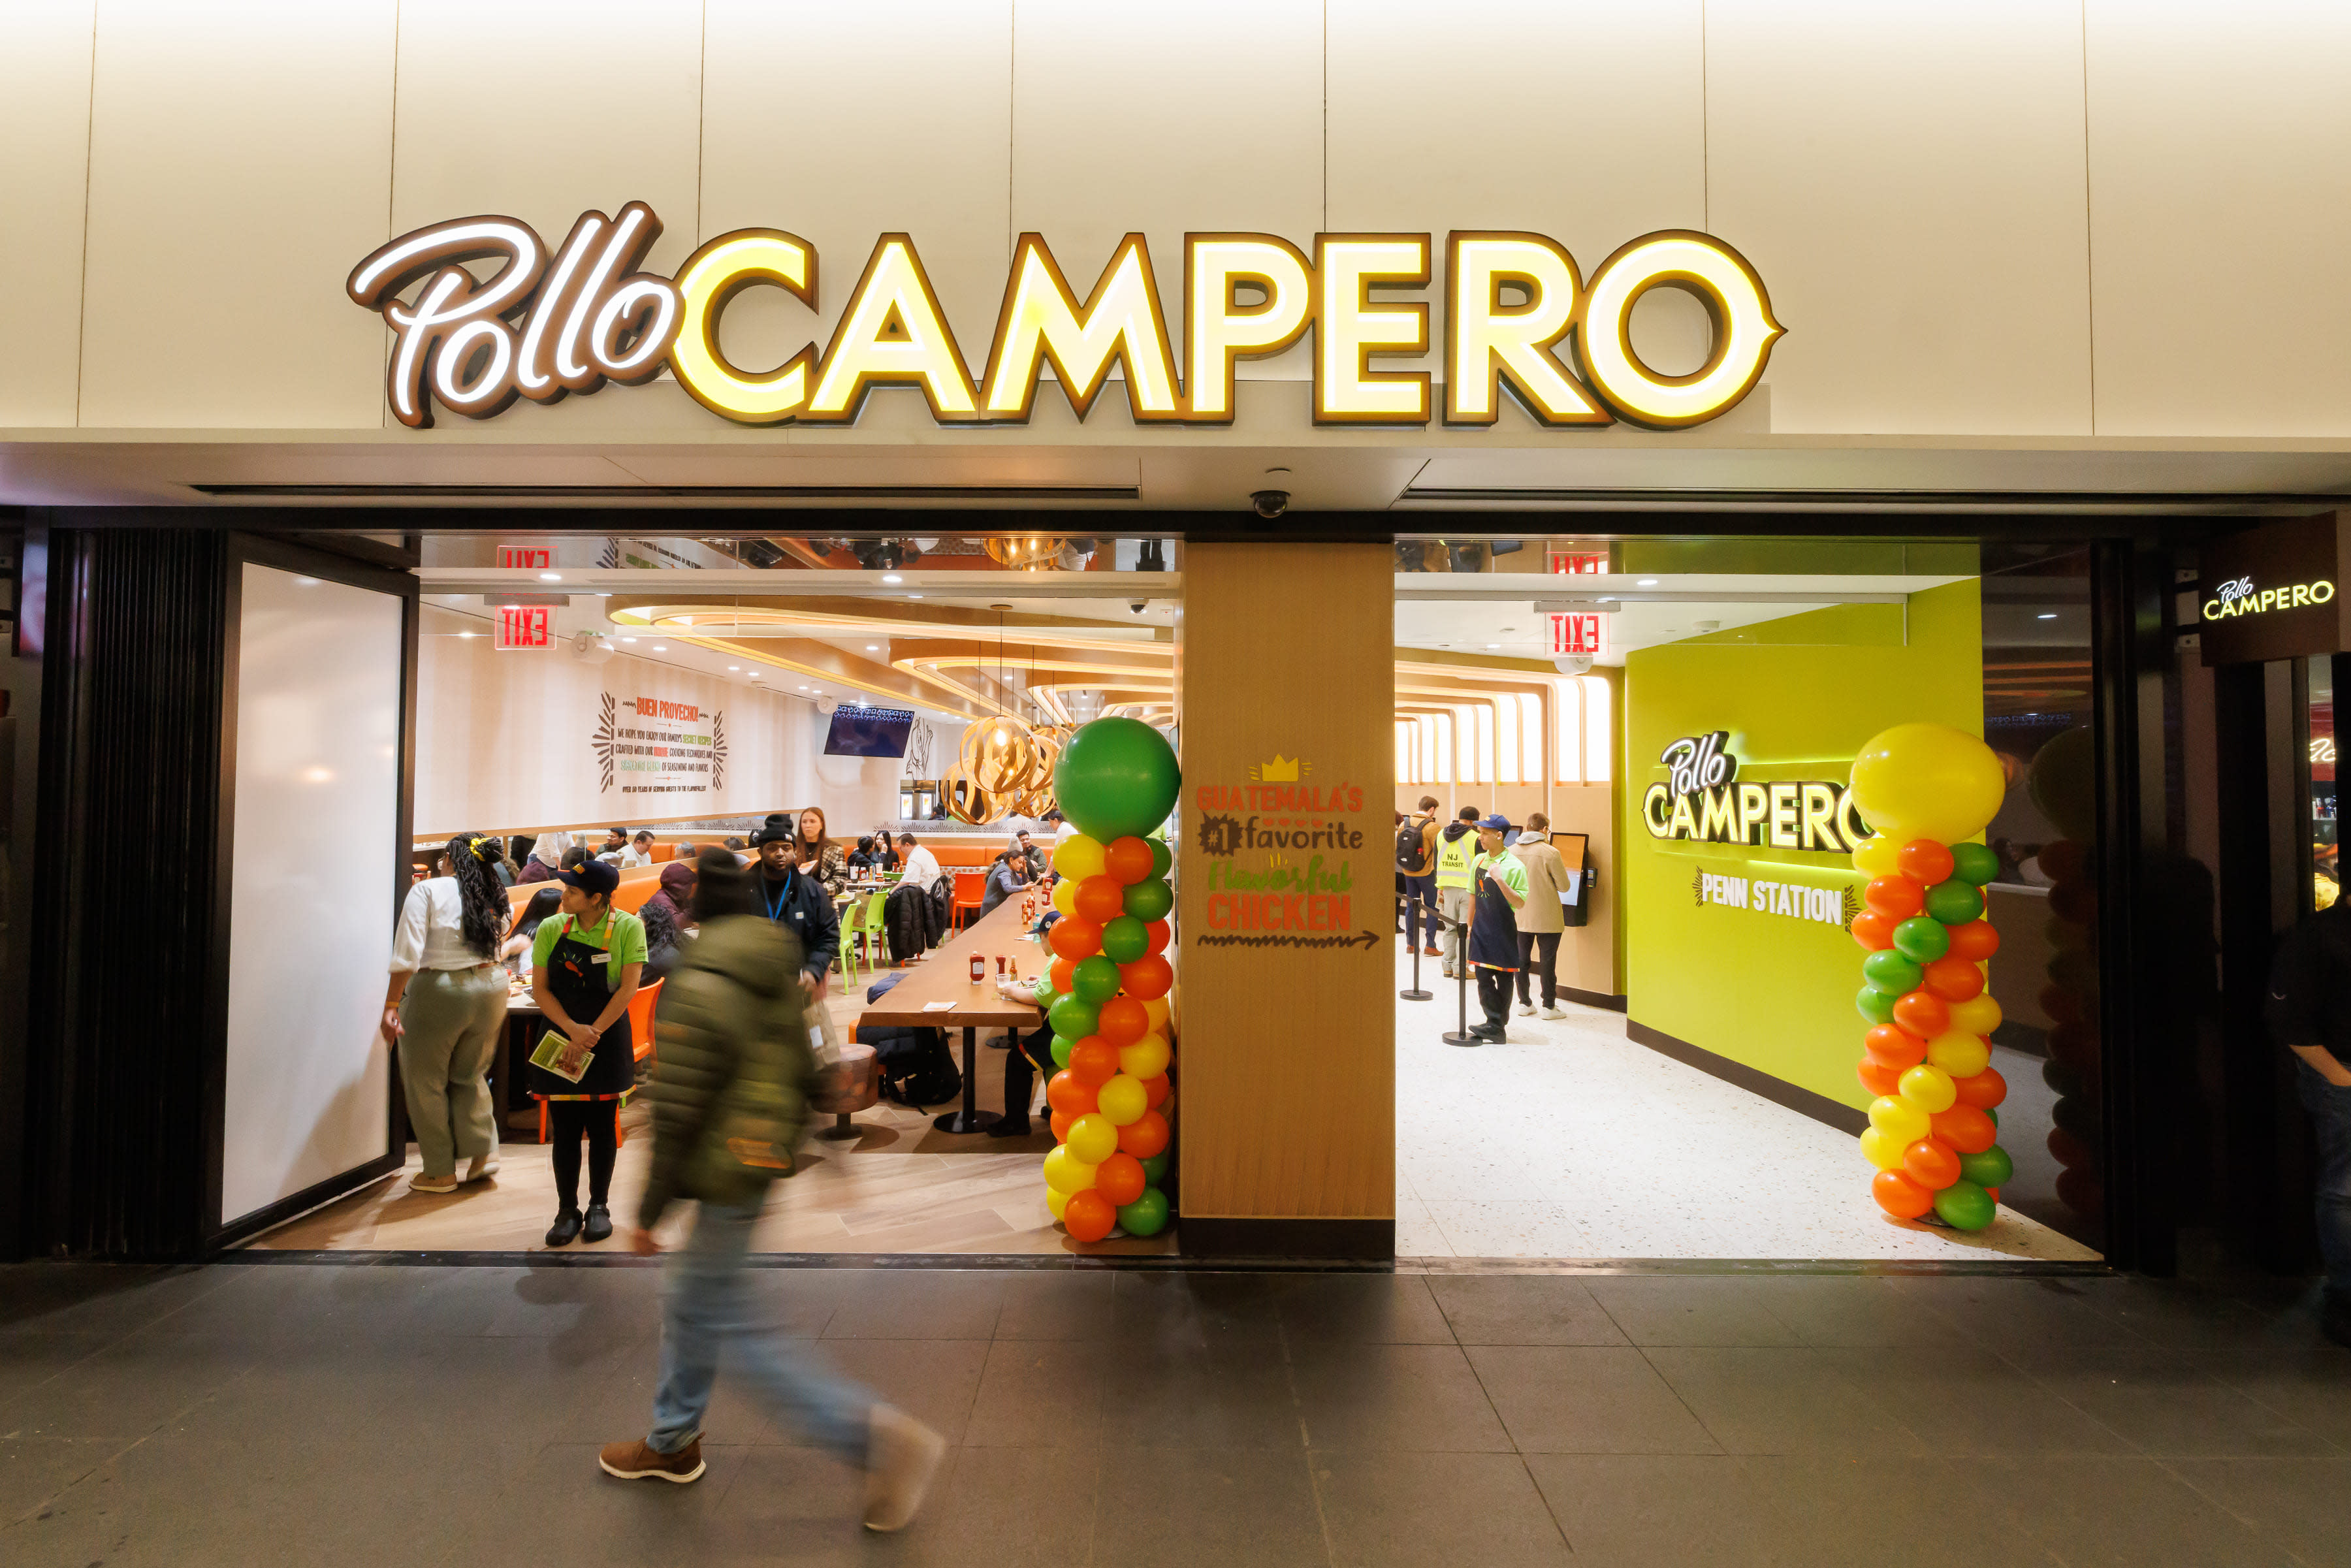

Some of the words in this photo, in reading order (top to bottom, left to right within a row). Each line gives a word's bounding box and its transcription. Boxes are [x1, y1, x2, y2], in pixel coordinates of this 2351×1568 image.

[349, 203, 677, 423] Pollo
[671, 230, 1787, 427] CAMPERO
[2203, 581, 2335, 620] CAMPERO
[2216, 575, 2253, 603] Pollo
[637, 696, 658, 718] BUEN
[659, 700, 699, 722] PROVECHO!
[625, 728, 637, 739] HOPE
[1661, 730, 1727, 799] Pollo
[1196, 781, 1363, 812] GUATEMALA'S
[1244, 816, 1363, 849] favorite
[1208, 854, 1352, 895] Flavorful
[1207, 893, 1351, 930] CHICKEN
[1702, 872, 1748, 909] PENN
[1753, 880, 1843, 925] STATION
